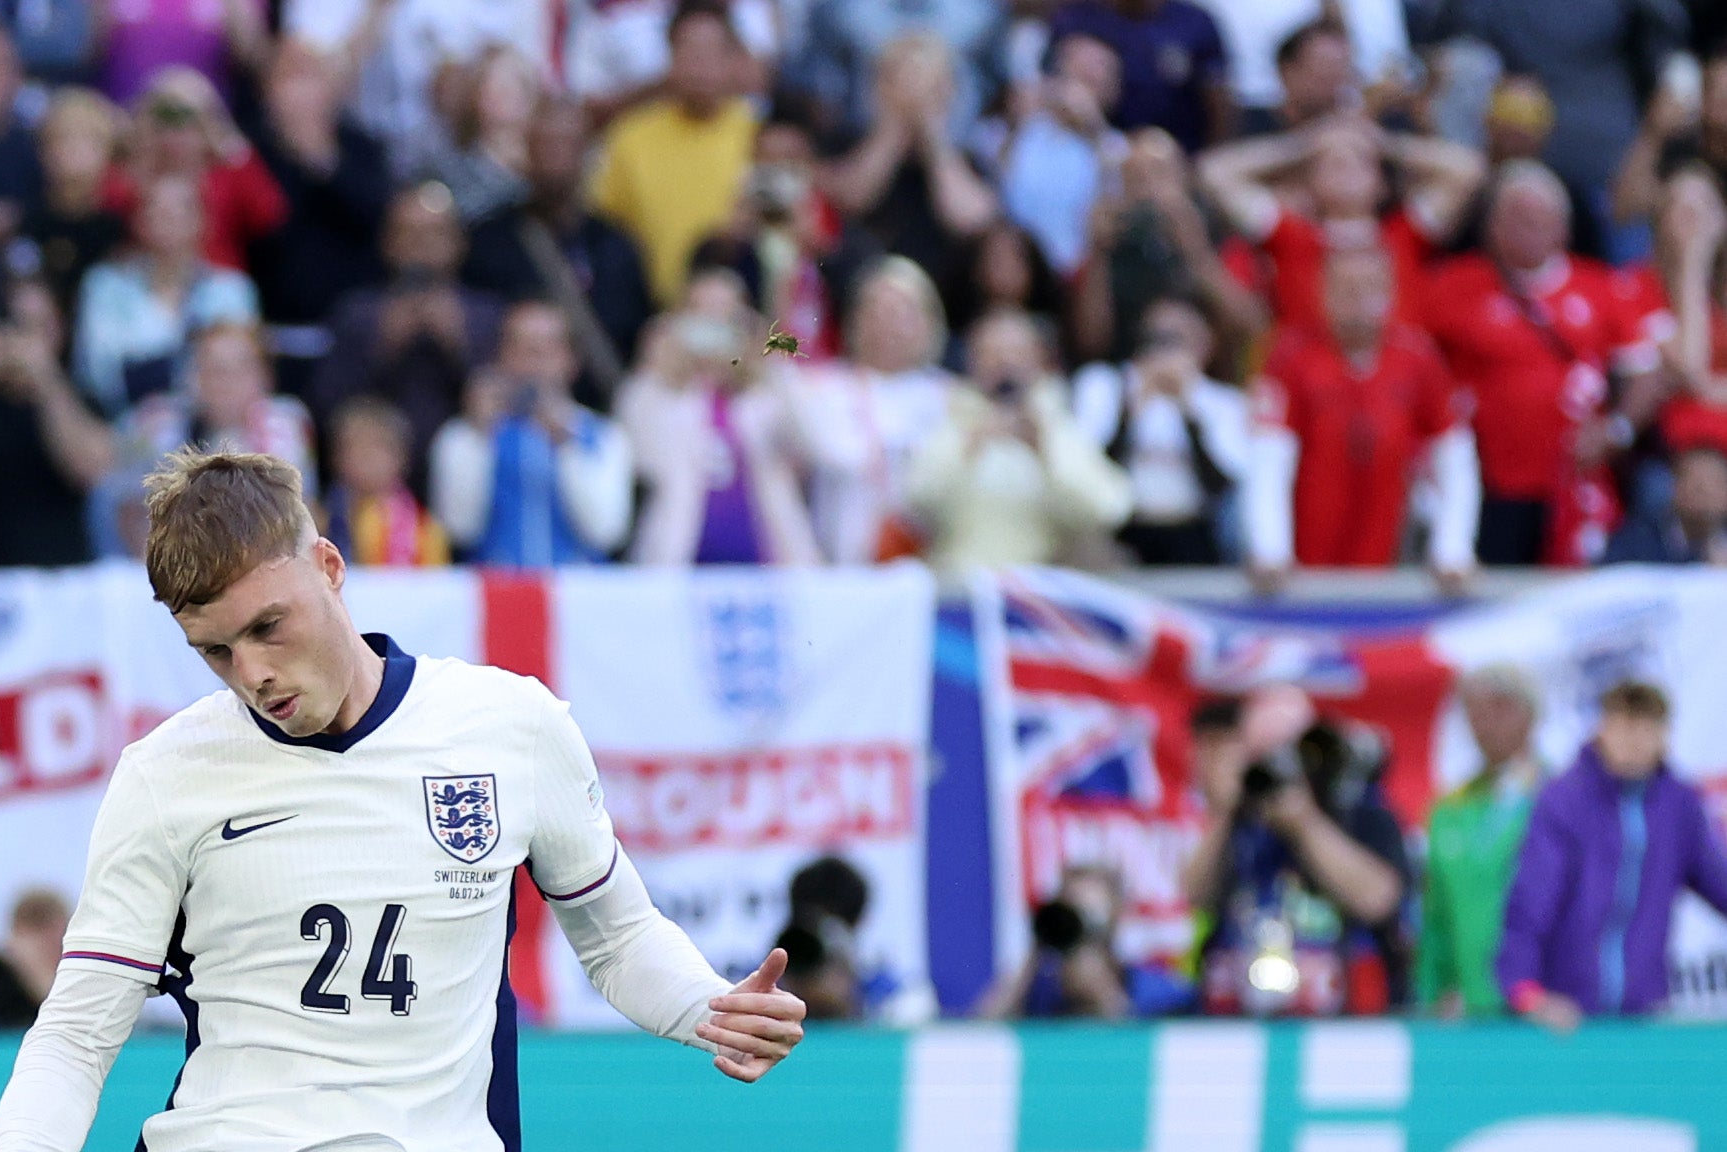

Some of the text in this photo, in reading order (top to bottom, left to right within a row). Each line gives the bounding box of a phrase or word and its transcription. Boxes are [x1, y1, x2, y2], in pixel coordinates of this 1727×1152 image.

[434, 870, 497, 884] SWITZERLAND
[449, 887, 485, 900] 06.07.24
[300, 903, 419, 1017] 24
